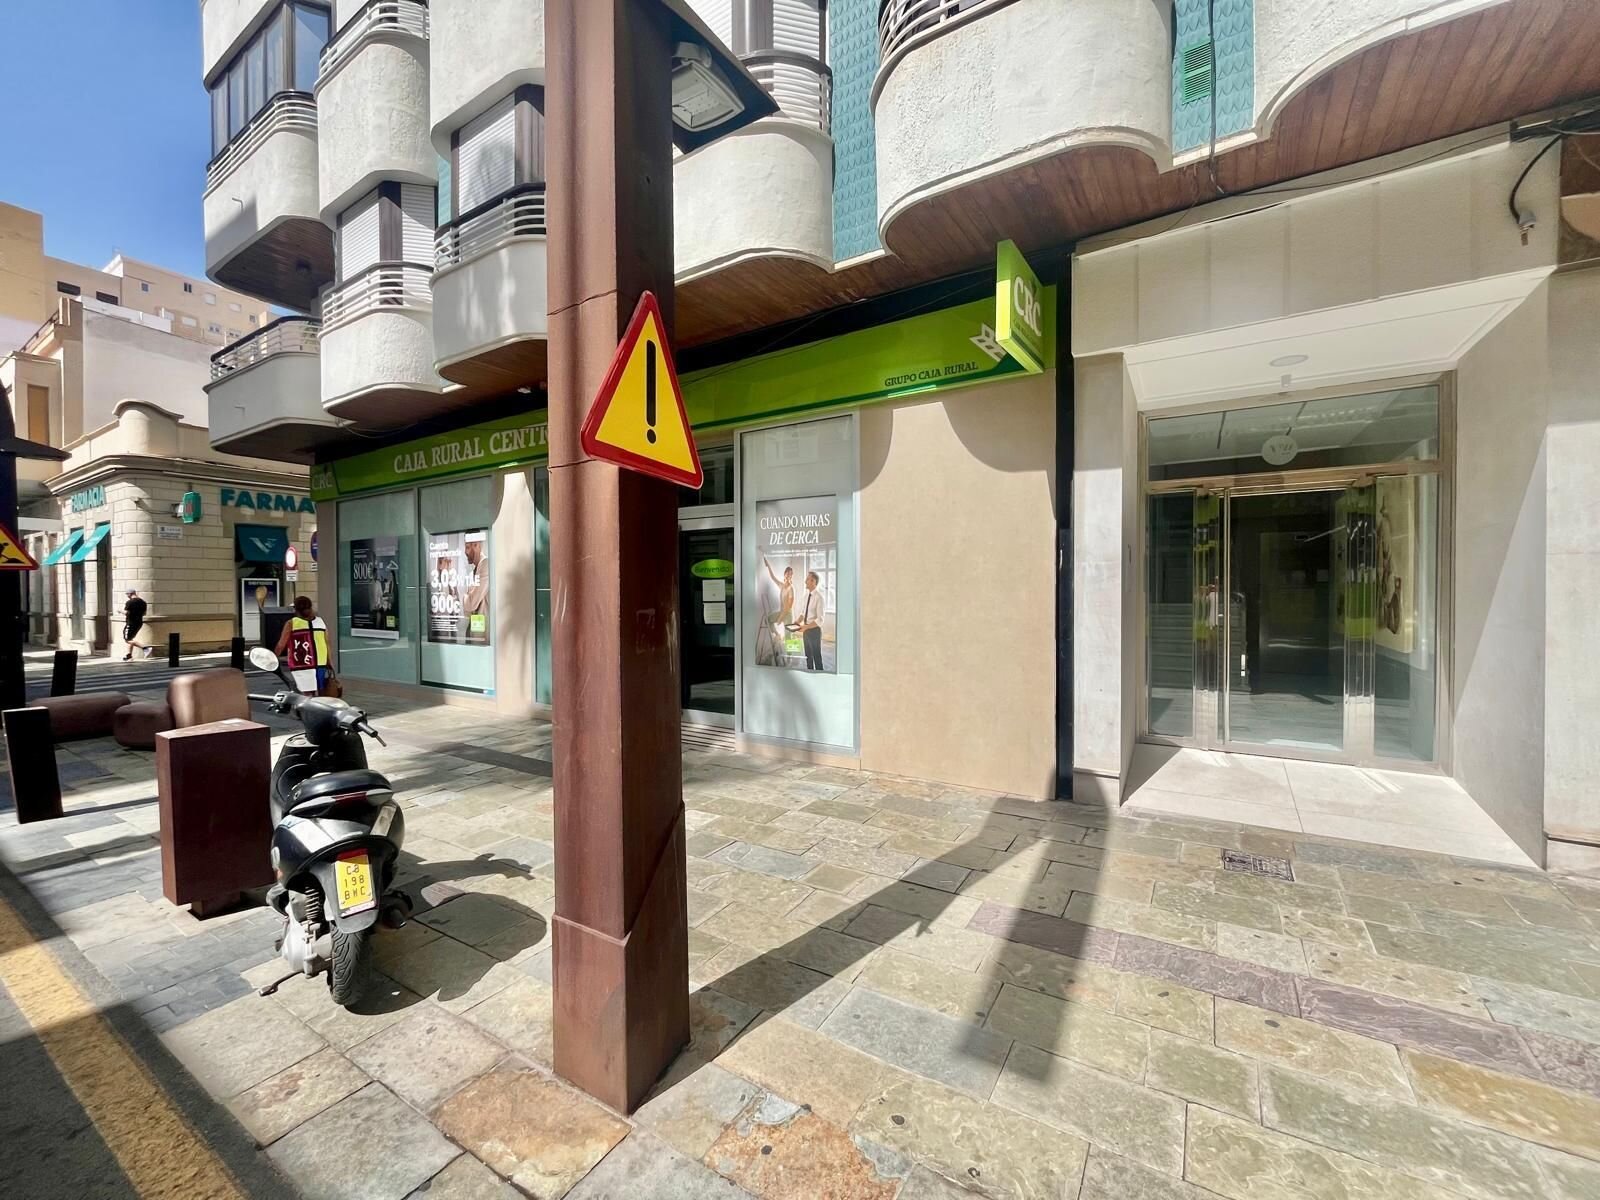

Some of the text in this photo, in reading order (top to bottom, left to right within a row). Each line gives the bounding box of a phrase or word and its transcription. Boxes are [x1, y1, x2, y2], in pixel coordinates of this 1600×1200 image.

[1014, 276, 1042, 337] CRC
[885, 373, 917, 387] GRUPO
[944, 361, 978, 376] RURAL
[394, 450, 428, 473] CAJA
[431, 437, 485, 467] RURAL
[71, 485, 107, 513] FARMACIA
[220, 488, 317, 514] FARMA
[760, 513, 831, 530] CUANDO MIRAS
[769, 530, 820, 546] DE CERCA
[344, 874, 365, 888] 198
